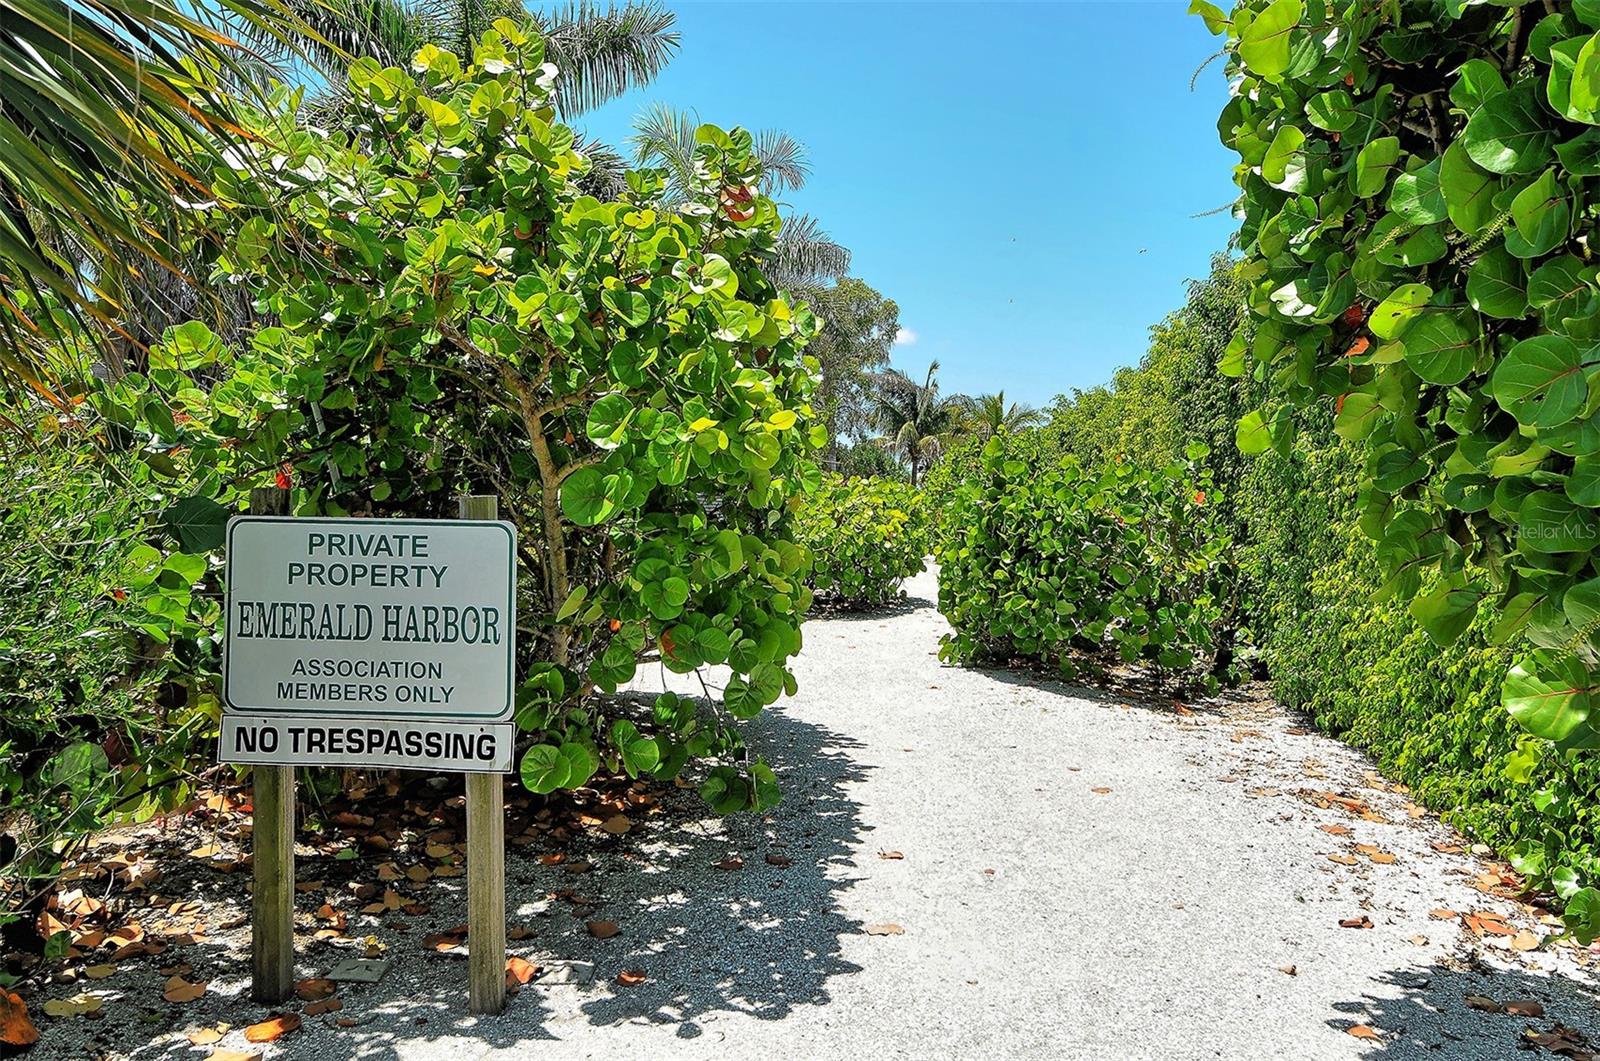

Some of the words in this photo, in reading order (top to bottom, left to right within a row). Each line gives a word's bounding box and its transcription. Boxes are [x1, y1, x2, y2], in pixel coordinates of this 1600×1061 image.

[308, 533, 429, 558] PRIVATE
[288, 562, 448, 588] PROPERTY
[237, 601, 373, 641] EMERALD
[382, 605, 501, 645] HARBOR
[291, 659, 442, 679] ASSOCIATION
[277, 682, 388, 701] MEMBERS
[395, 685, 454, 703] ONLY
[235, 727, 278, 753] NO
[288, 727, 496, 760] TRESPASSING
